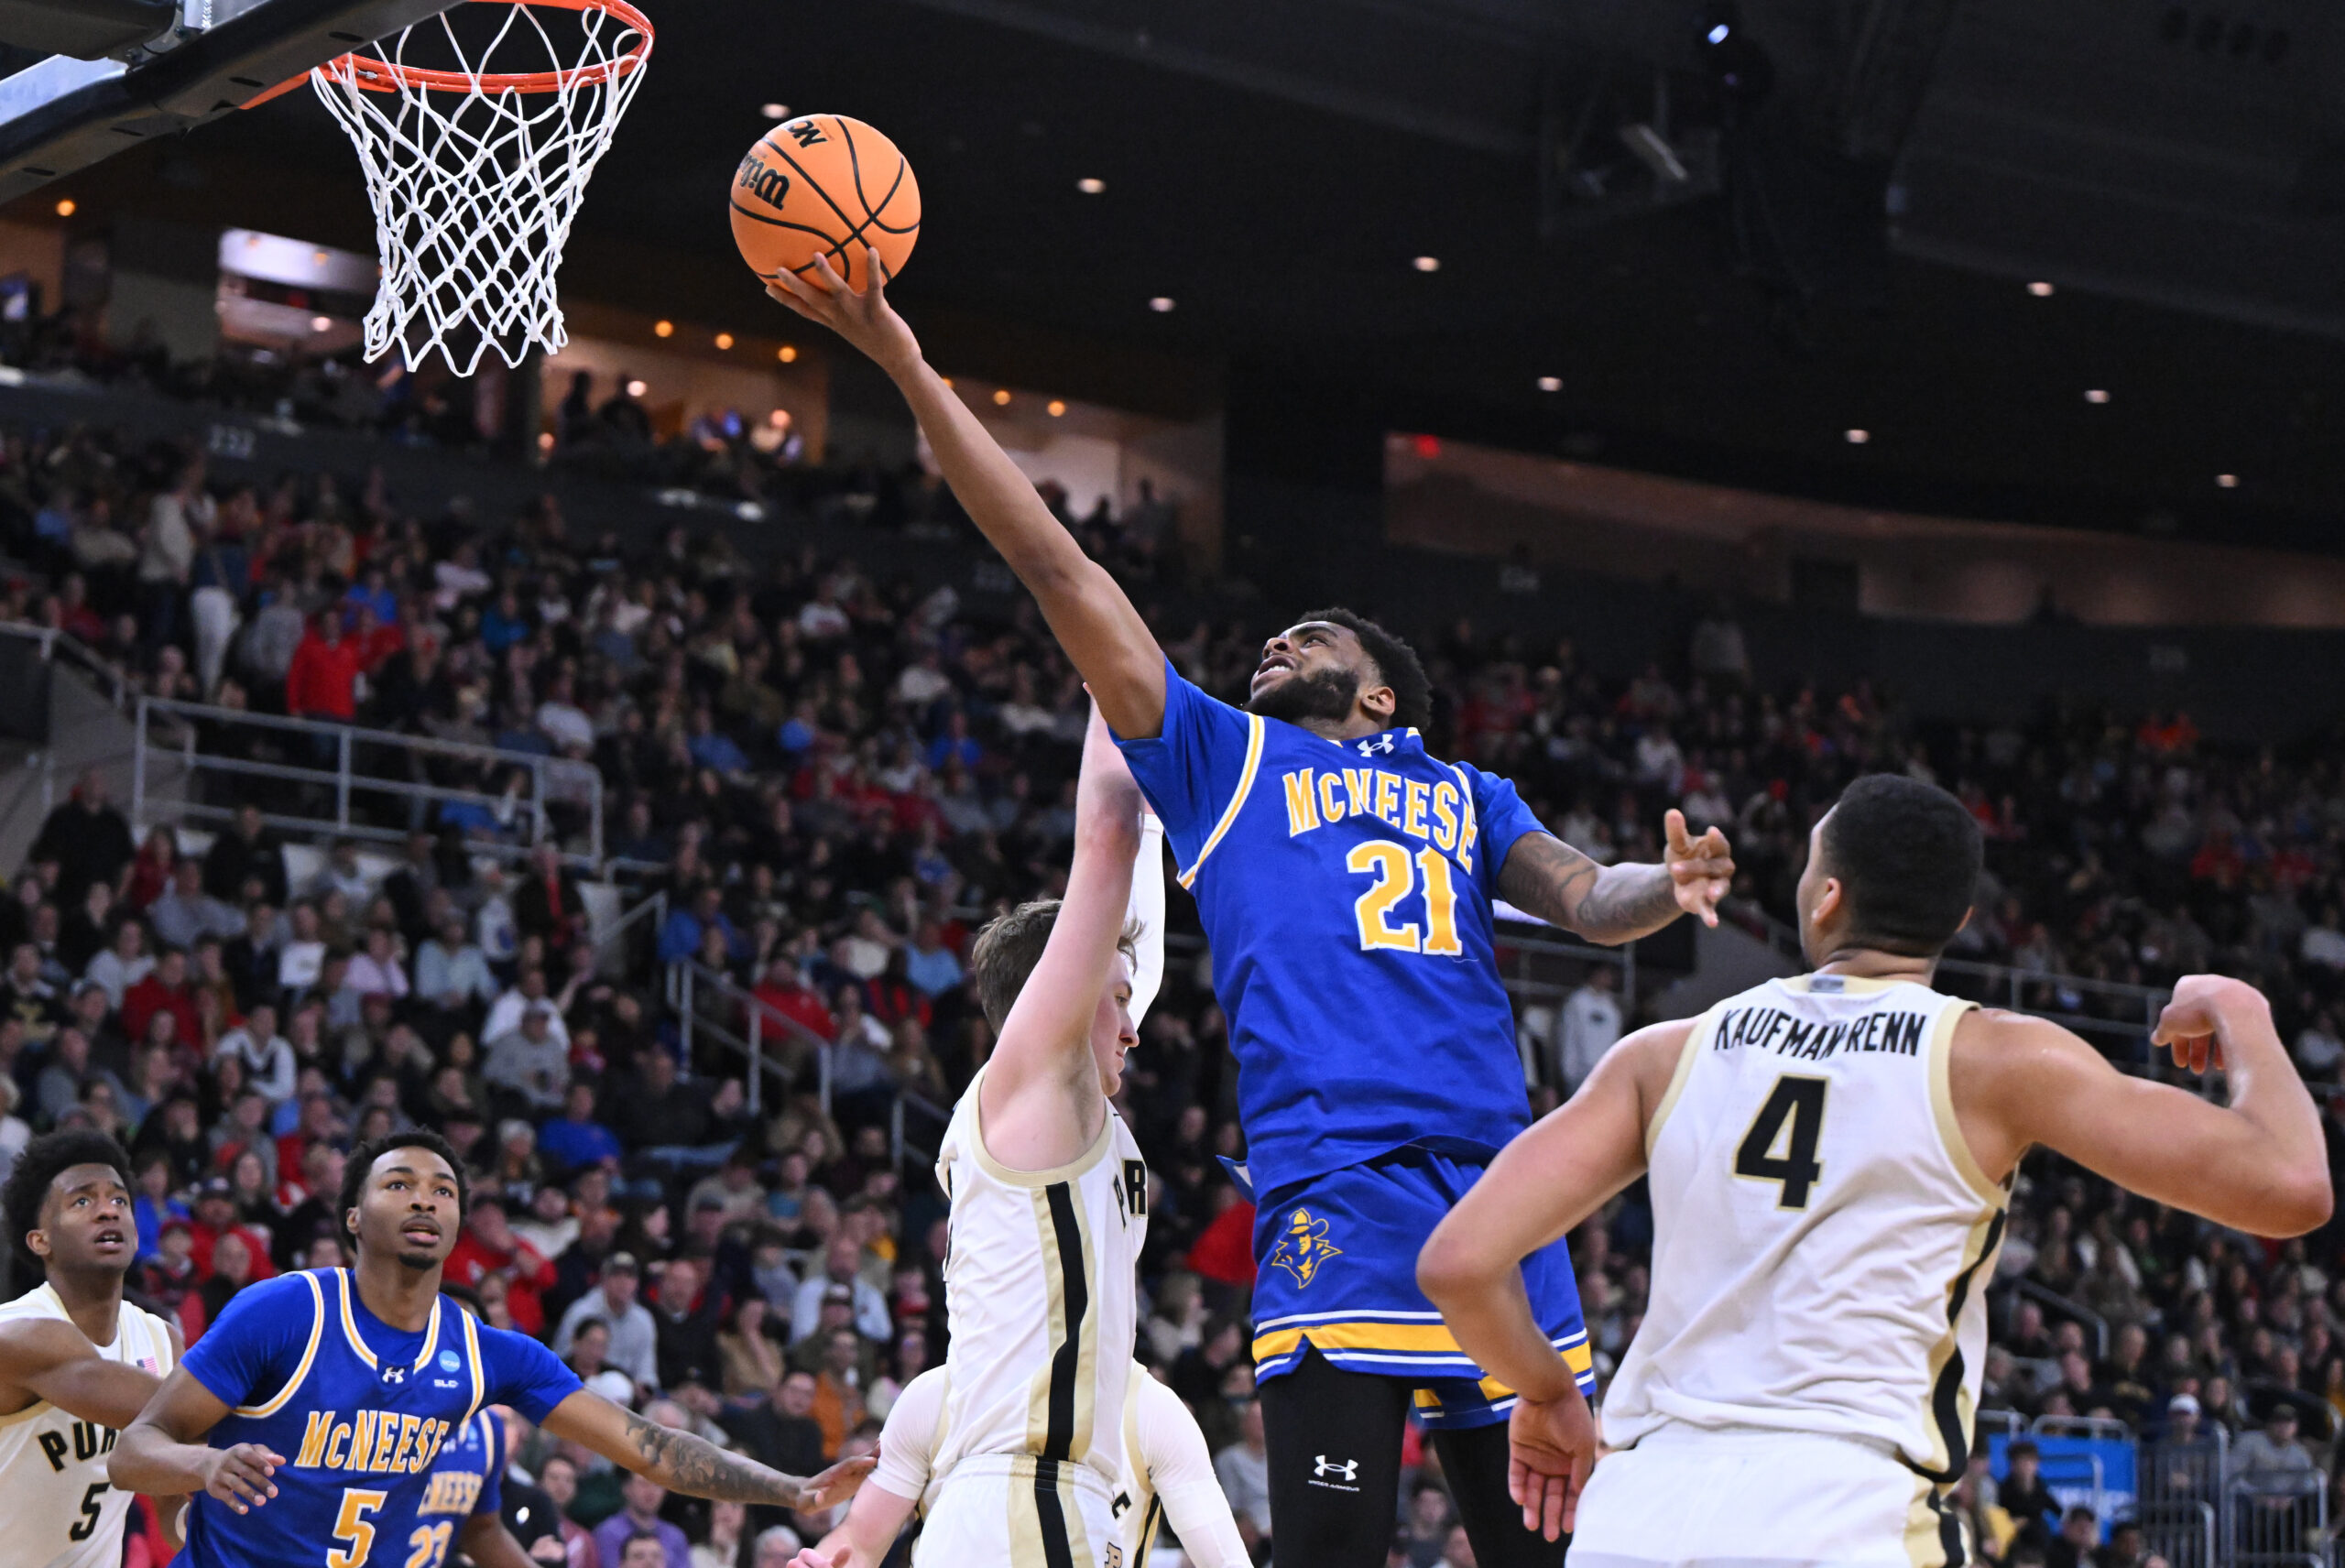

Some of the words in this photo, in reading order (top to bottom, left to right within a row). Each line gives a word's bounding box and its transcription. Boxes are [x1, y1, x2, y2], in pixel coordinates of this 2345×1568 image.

[1346, 839, 1462, 956] 21
[1732, 1072, 1830, 1213] 4
[38, 1421, 117, 1473] PUR
[69, 1482, 111, 1541] 5
[325, 1487, 388, 1568] 5
